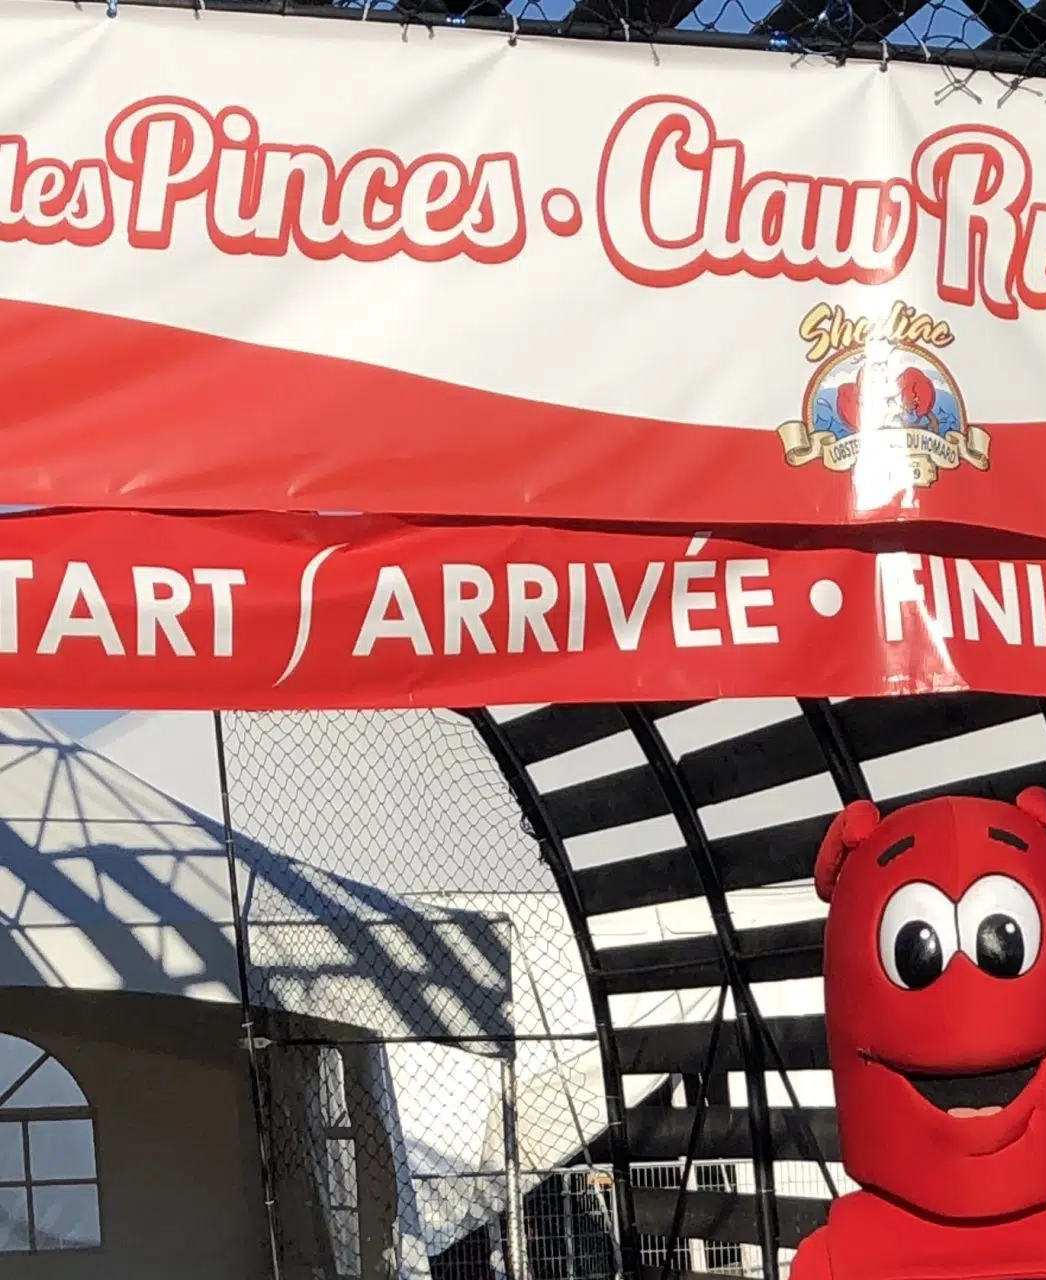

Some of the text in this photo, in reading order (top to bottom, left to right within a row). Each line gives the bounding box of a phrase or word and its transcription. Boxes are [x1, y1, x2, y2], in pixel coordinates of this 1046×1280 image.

[106, 95, 526, 264] Pinces
[596, 94, 918, 287] Claw
[906, 432, 919, 449] DU
[351, 531, 779, 656] ARRIVÉE
